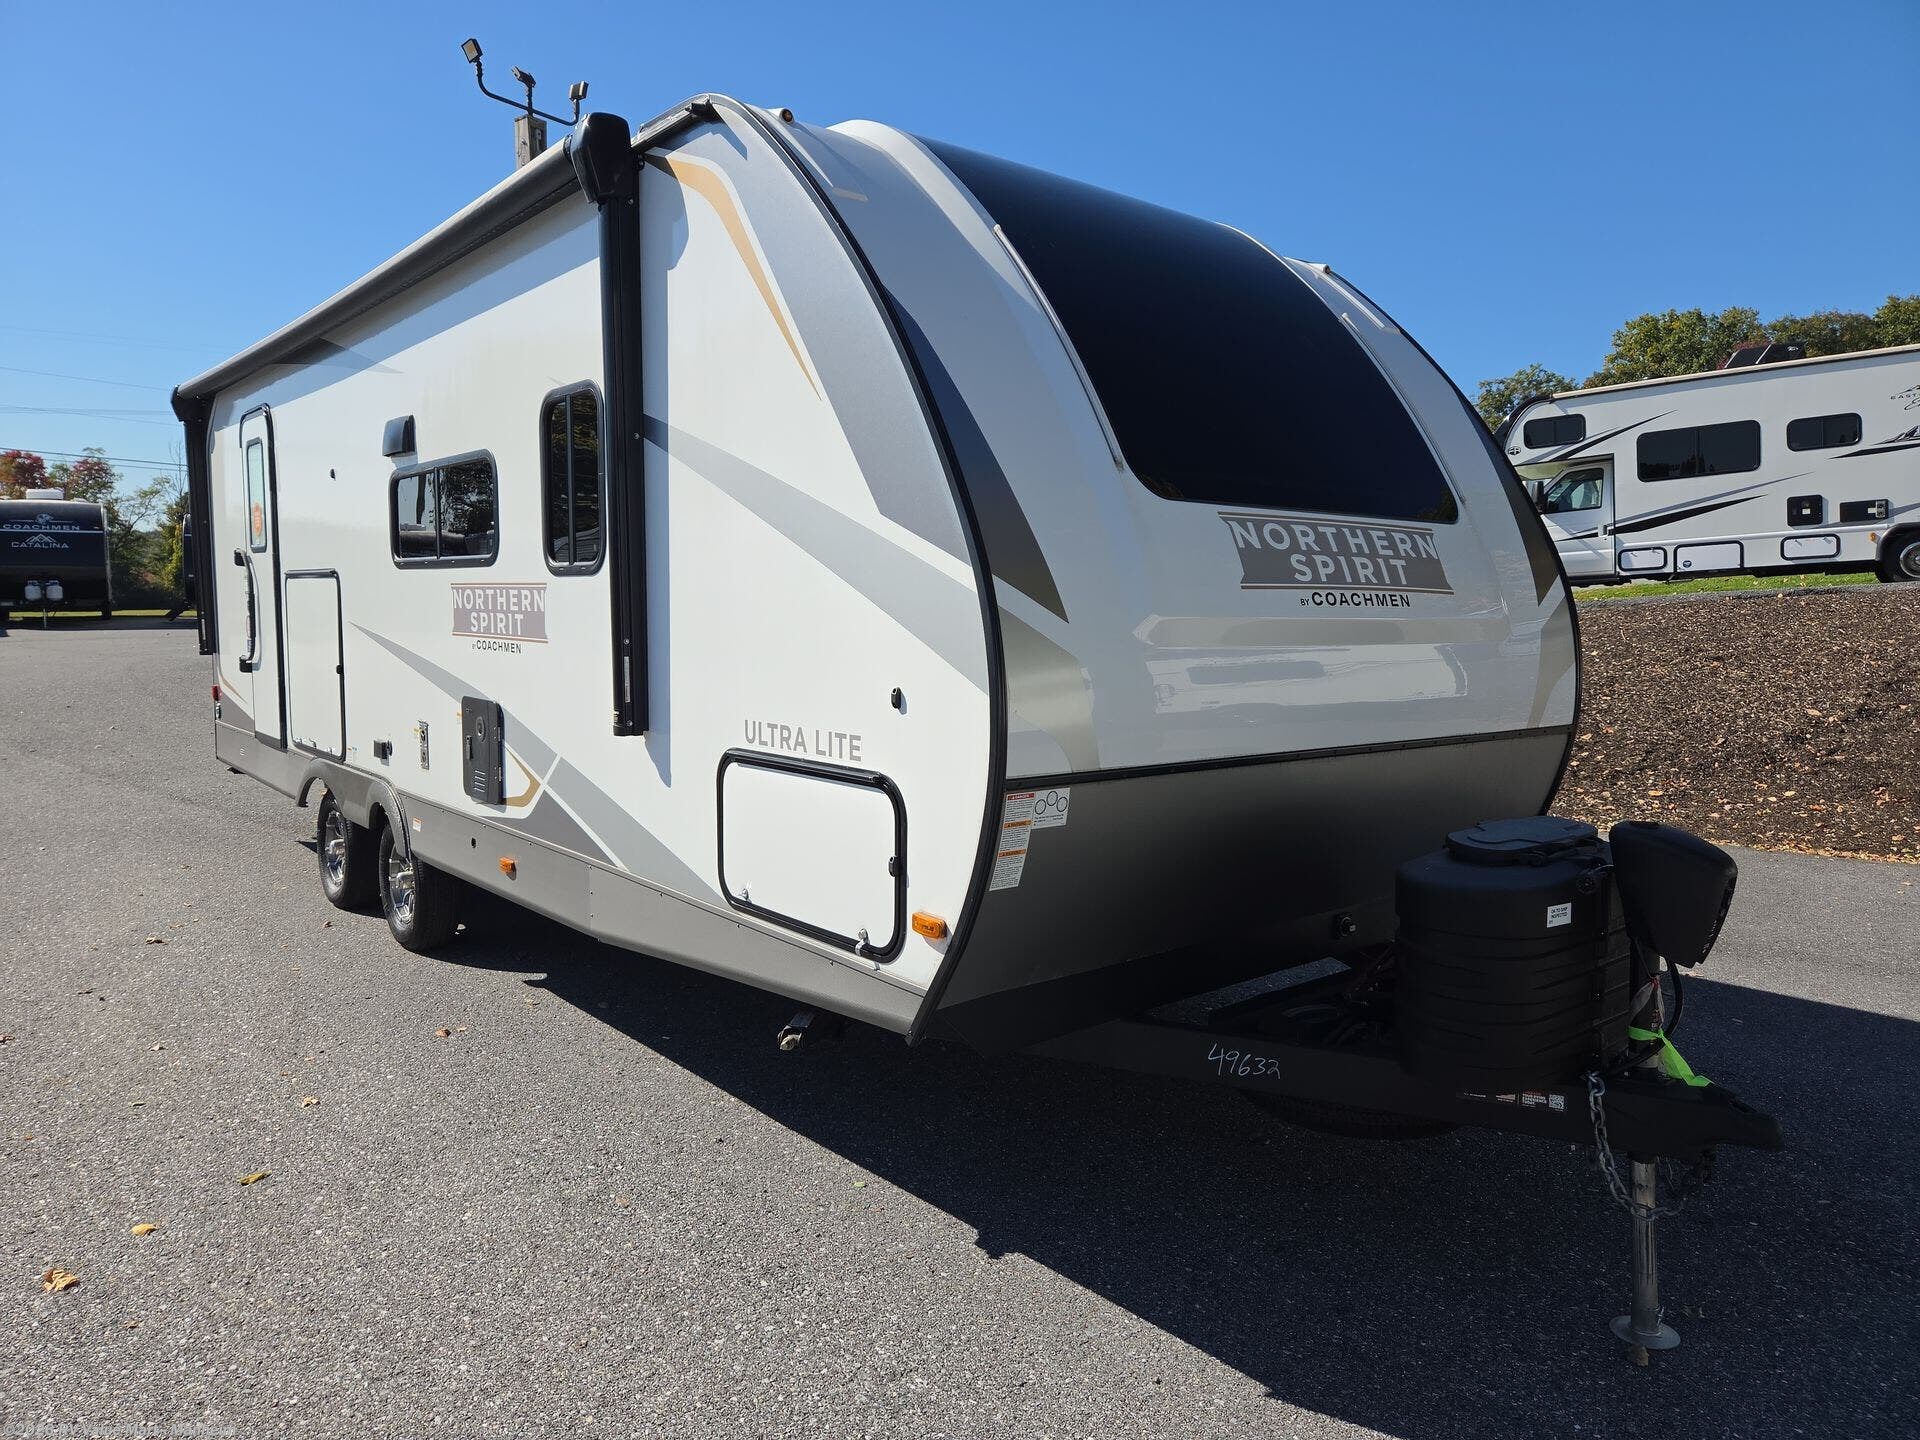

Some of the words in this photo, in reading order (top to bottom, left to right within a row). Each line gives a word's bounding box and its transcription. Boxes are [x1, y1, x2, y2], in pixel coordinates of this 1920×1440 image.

[1227, 520, 1439, 559] NORTHERN
[1290, 553, 1408, 585] SPIRIT
[453, 588, 545, 612] NORTHERN
[1300, 598, 1310, 606] BY
[1311, 591, 1411, 607] COACHMEN
[470, 612, 524, 635] SPIRIT
[476, 639, 522, 653] COACHMEN
[744, 719, 807, 753] ULTRA
[815, 729, 861, 762] LITE
[1207, 1043, 1281, 1080] 49632
